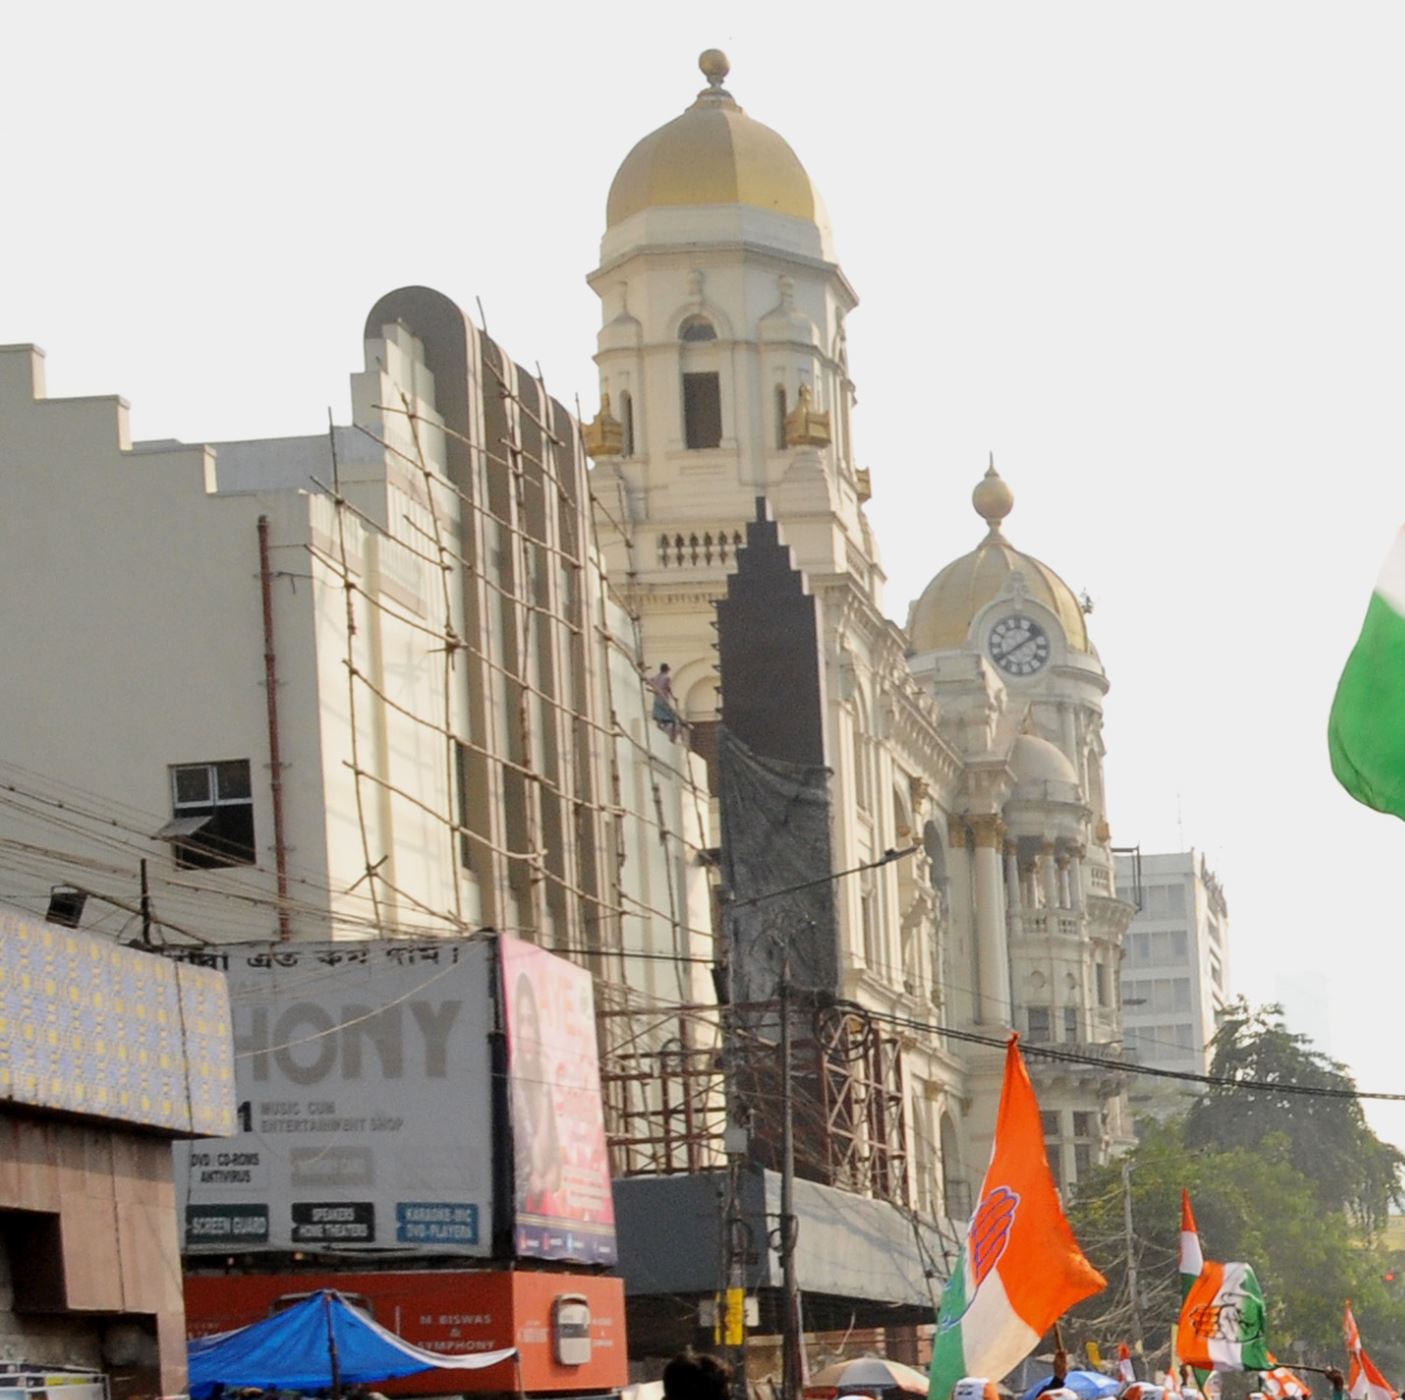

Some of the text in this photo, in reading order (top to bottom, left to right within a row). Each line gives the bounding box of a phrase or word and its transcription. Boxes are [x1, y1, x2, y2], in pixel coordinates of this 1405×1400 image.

[200, 1170, 251, 1183] ANTIVIRUS
[313, 1207, 355, 1221] SPEAKERS
[193, 1217, 267, 1234] SCREEN GUARD
